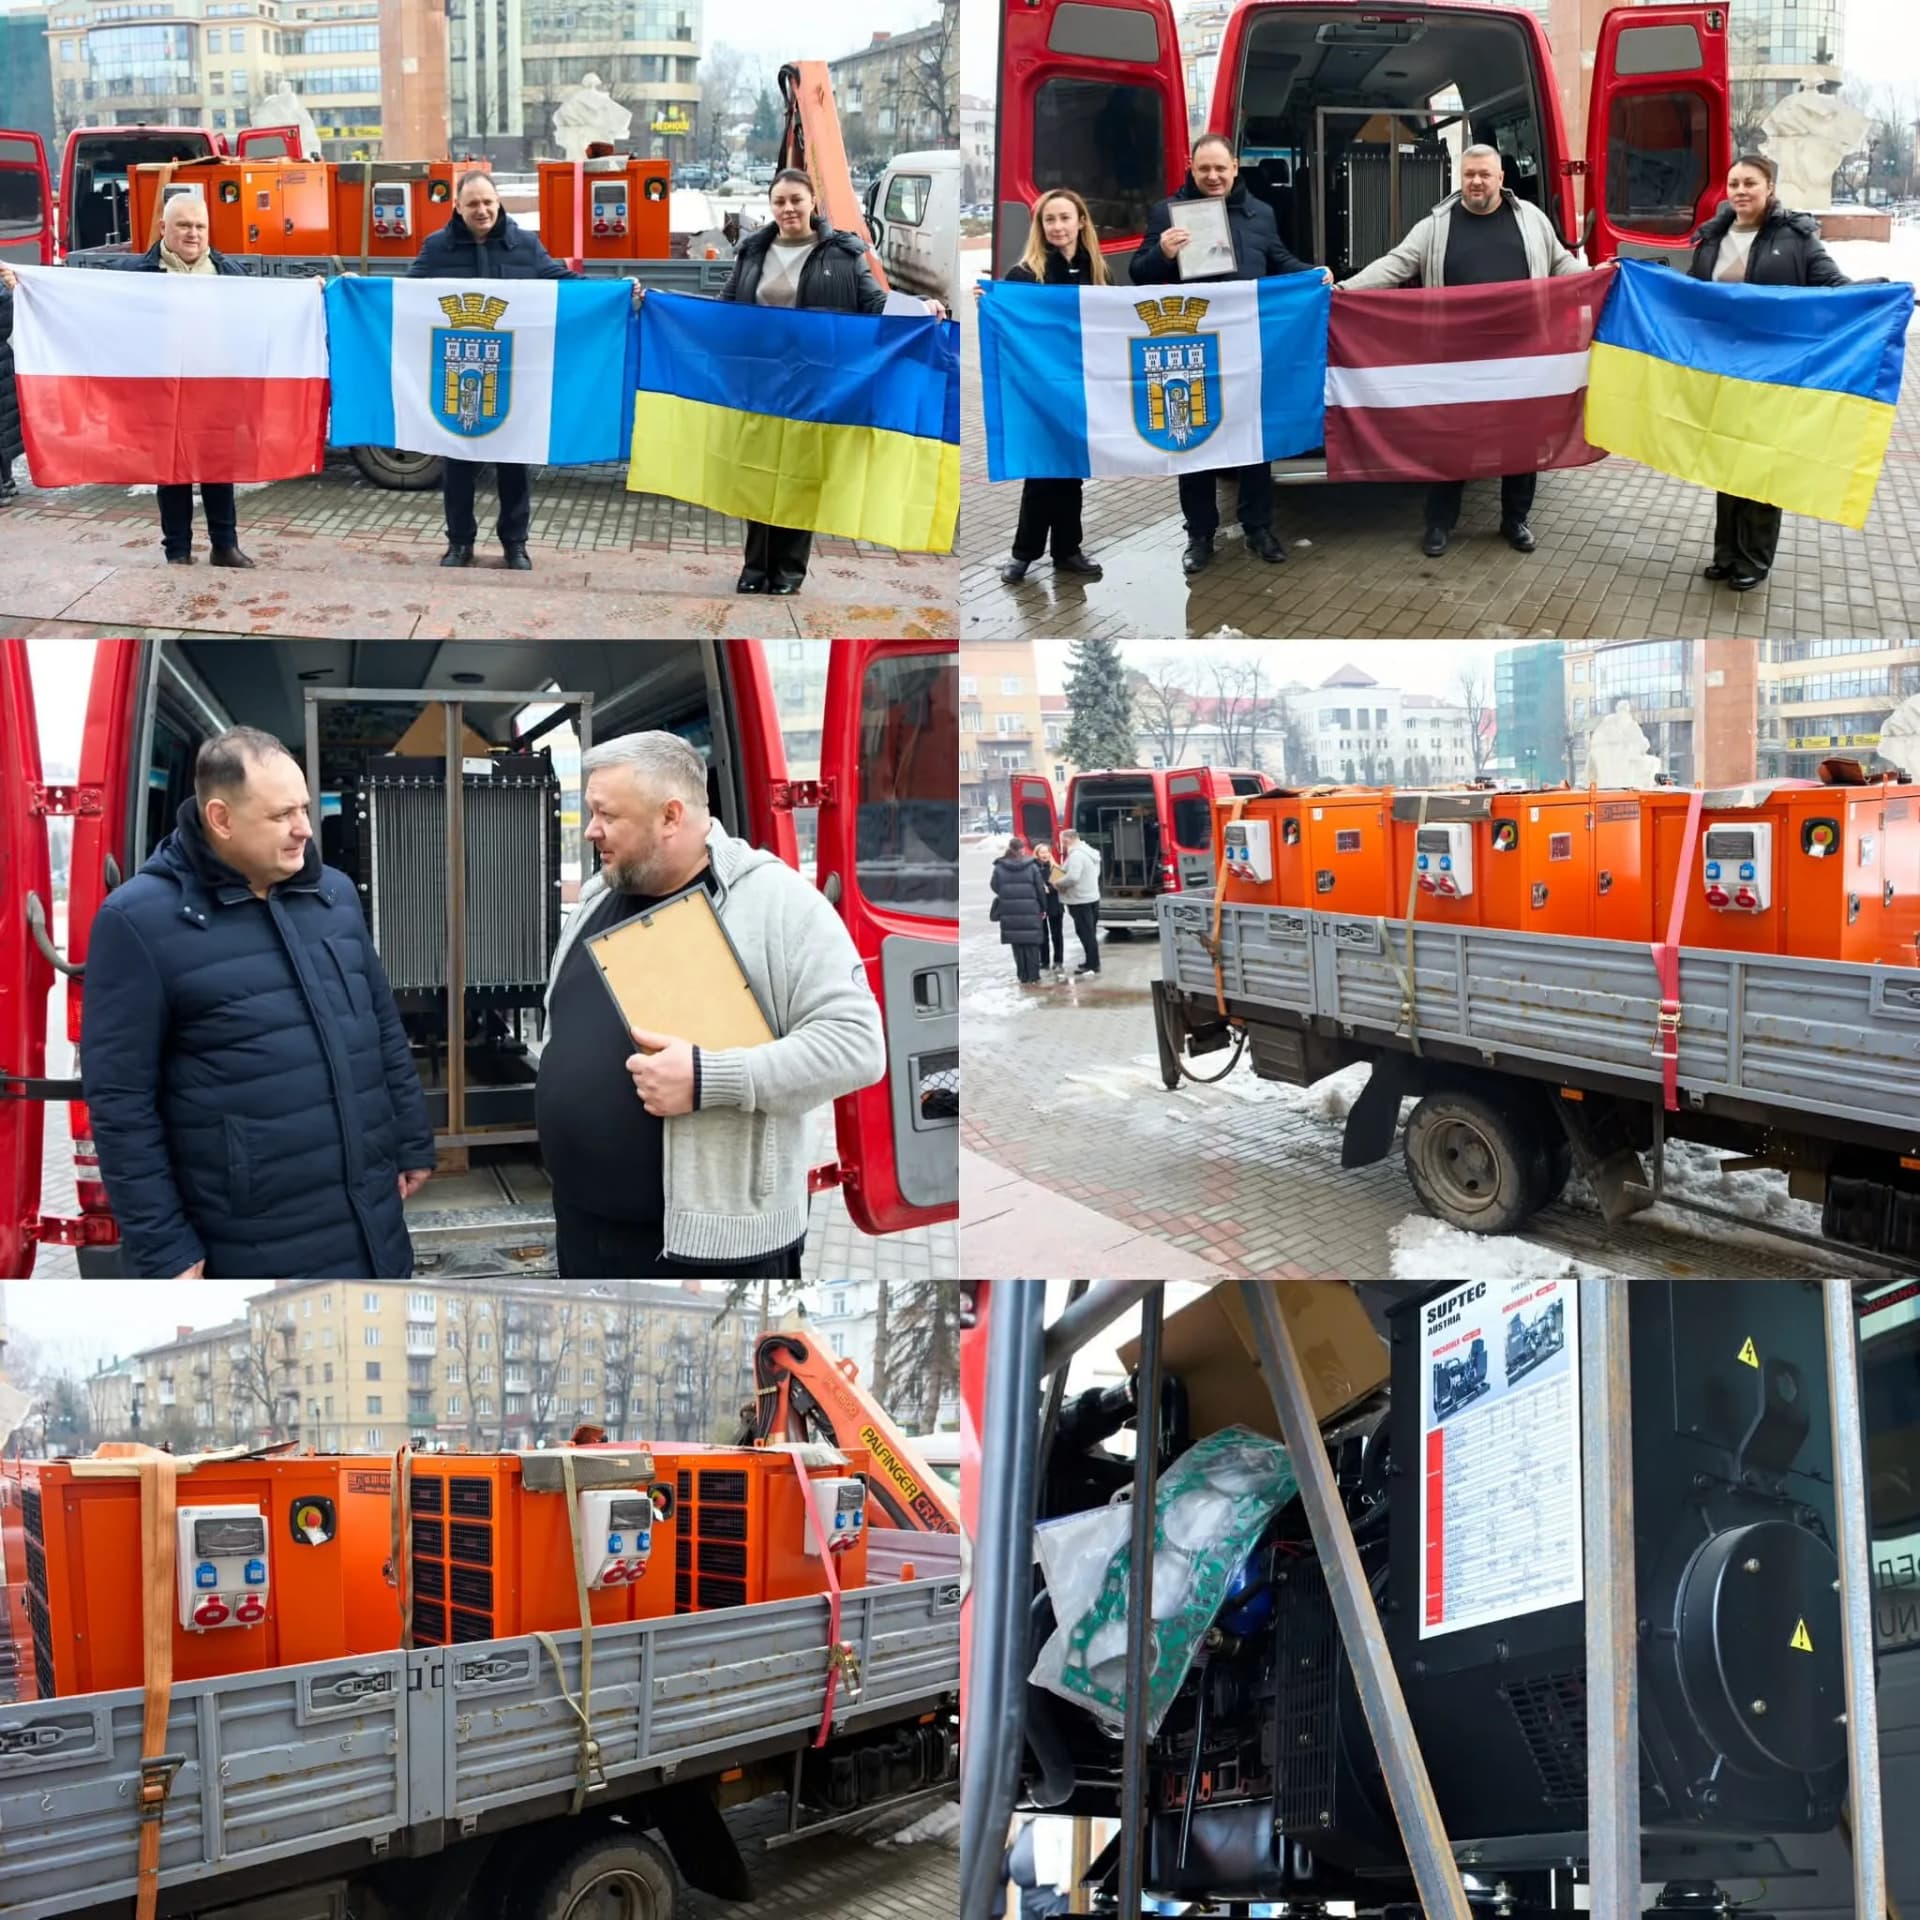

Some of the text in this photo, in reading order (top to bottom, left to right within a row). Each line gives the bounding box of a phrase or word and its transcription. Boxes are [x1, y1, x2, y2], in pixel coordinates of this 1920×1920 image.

[1427, 1281, 1487, 1324] SUPTEC
[1427, 1313, 1461, 1337] AUSTRIA
[862, 1428, 918, 1499] PALFINGER
